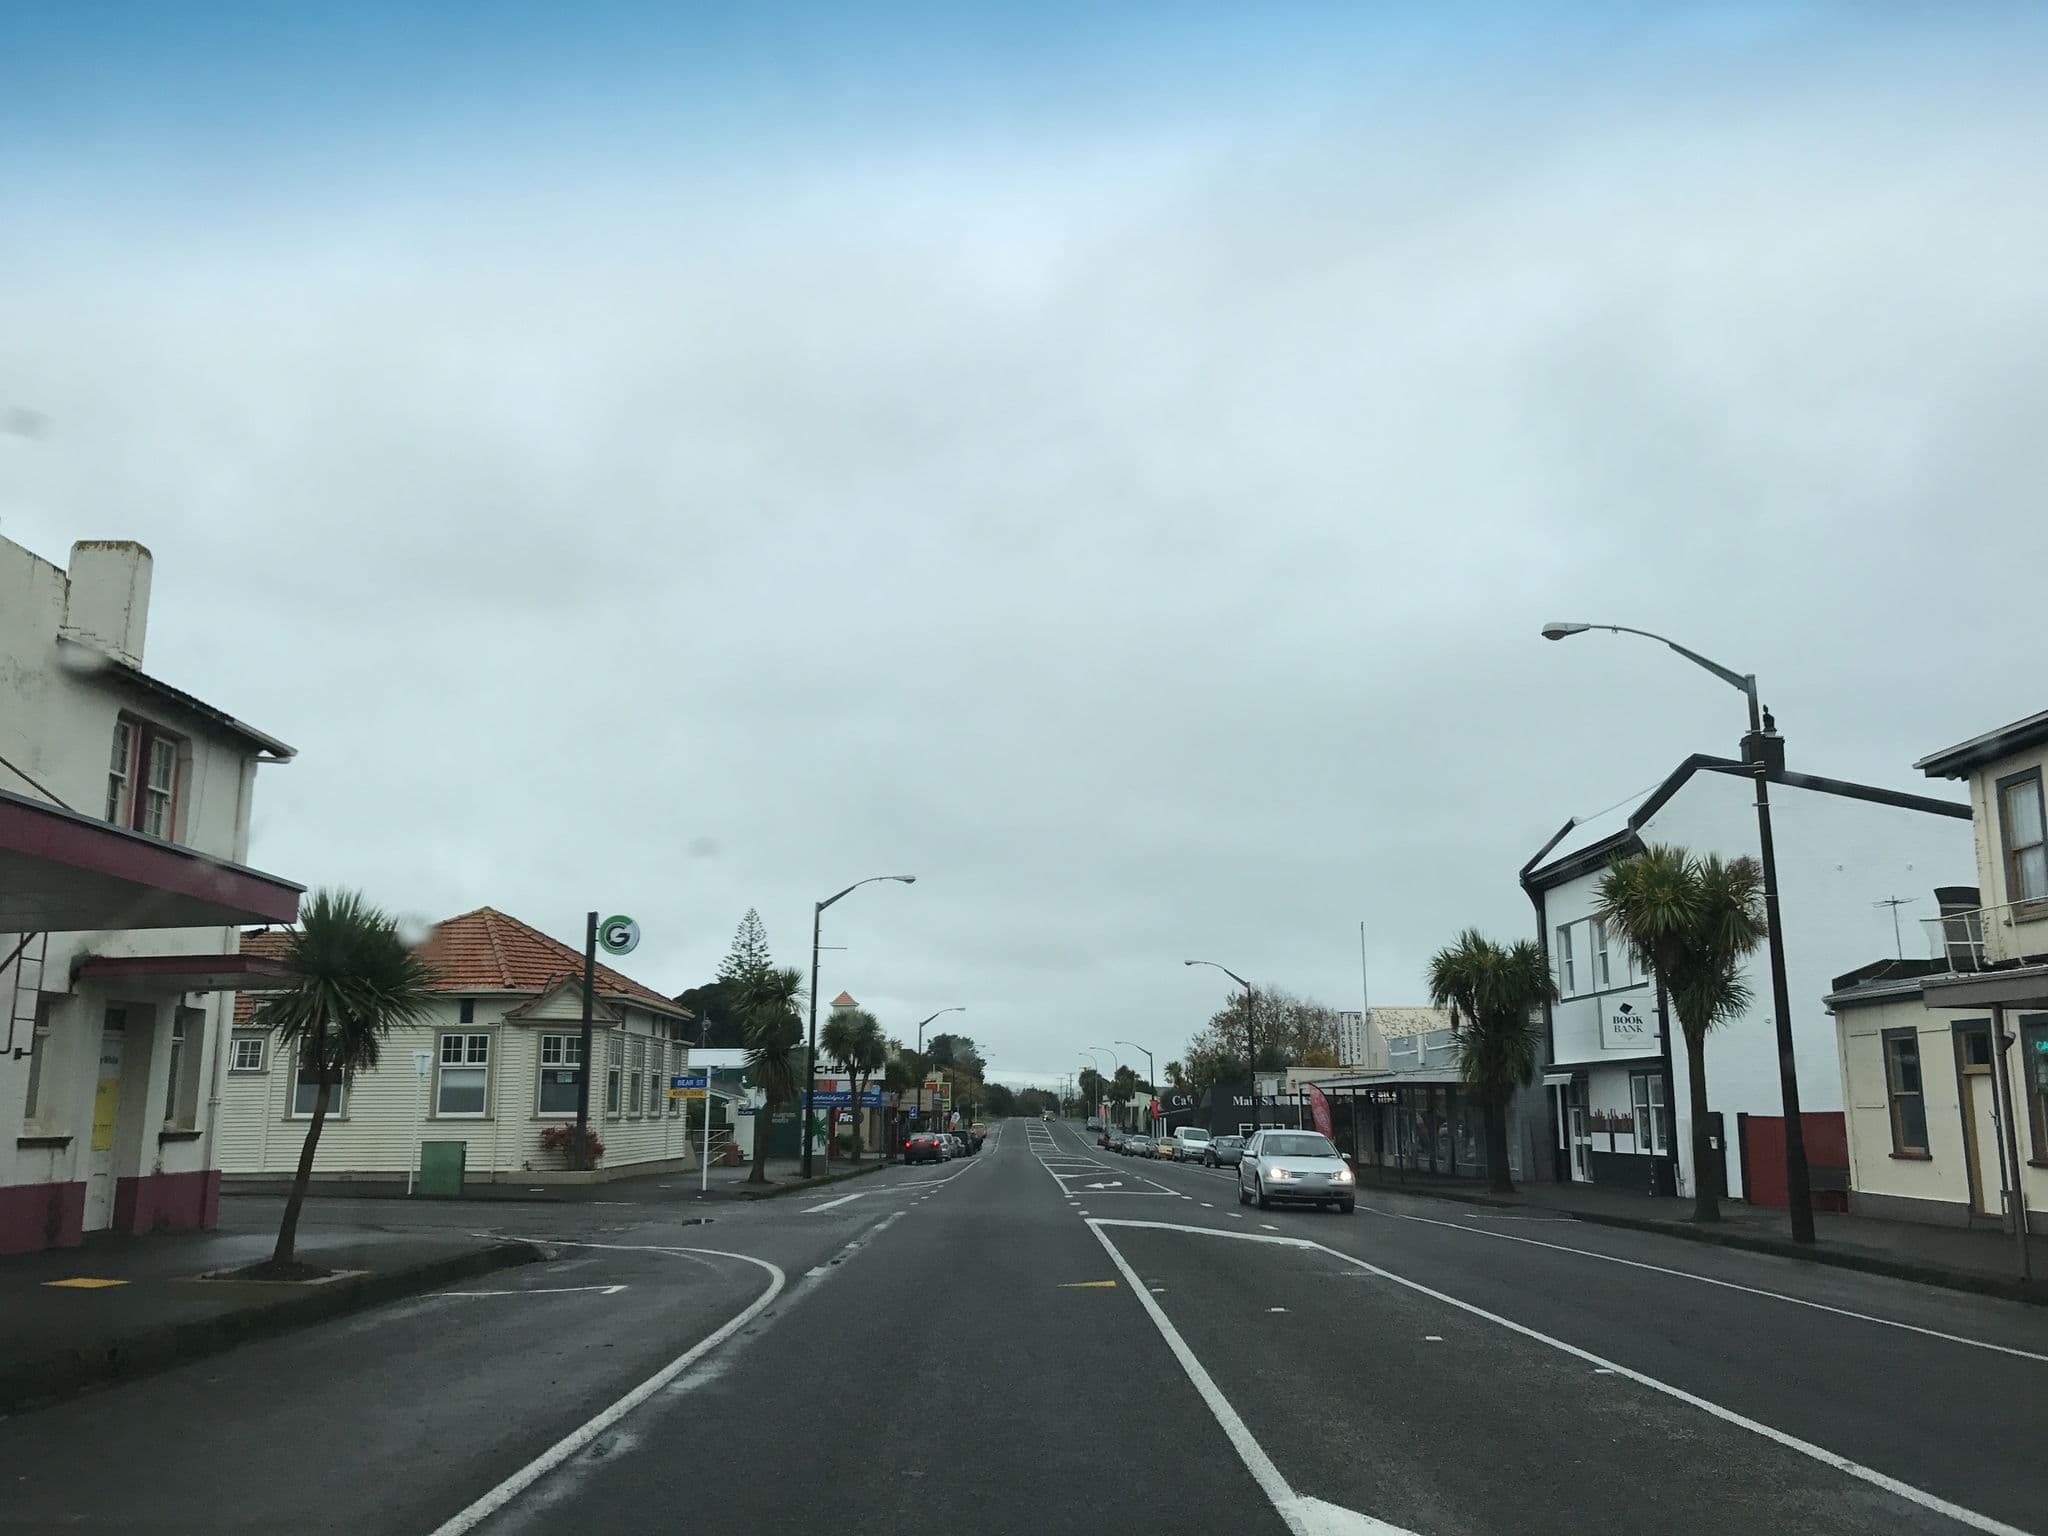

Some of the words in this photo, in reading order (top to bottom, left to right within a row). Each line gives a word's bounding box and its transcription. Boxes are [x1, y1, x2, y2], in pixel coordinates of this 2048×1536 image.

[606, 923, 630, 947] G
[1612, 1015, 1643, 1025] BOOK
[1614, 1025, 1643, 1033] BANK
